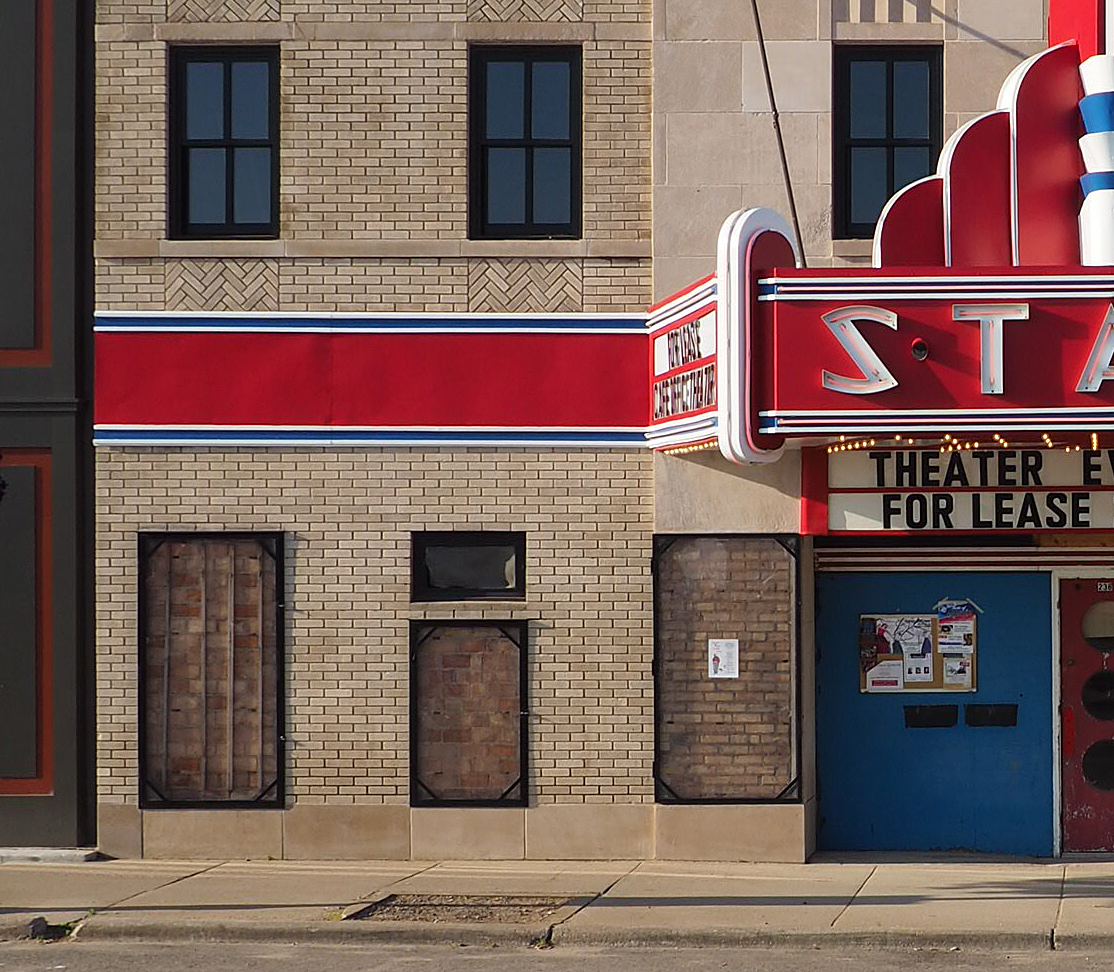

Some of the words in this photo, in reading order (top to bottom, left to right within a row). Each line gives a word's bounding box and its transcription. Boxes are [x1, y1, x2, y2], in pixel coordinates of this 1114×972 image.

[869, 449, 1043, 487] THEATER
[882, 493, 954, 529] FOR
[972, 492, 1090, 528] LEASE
